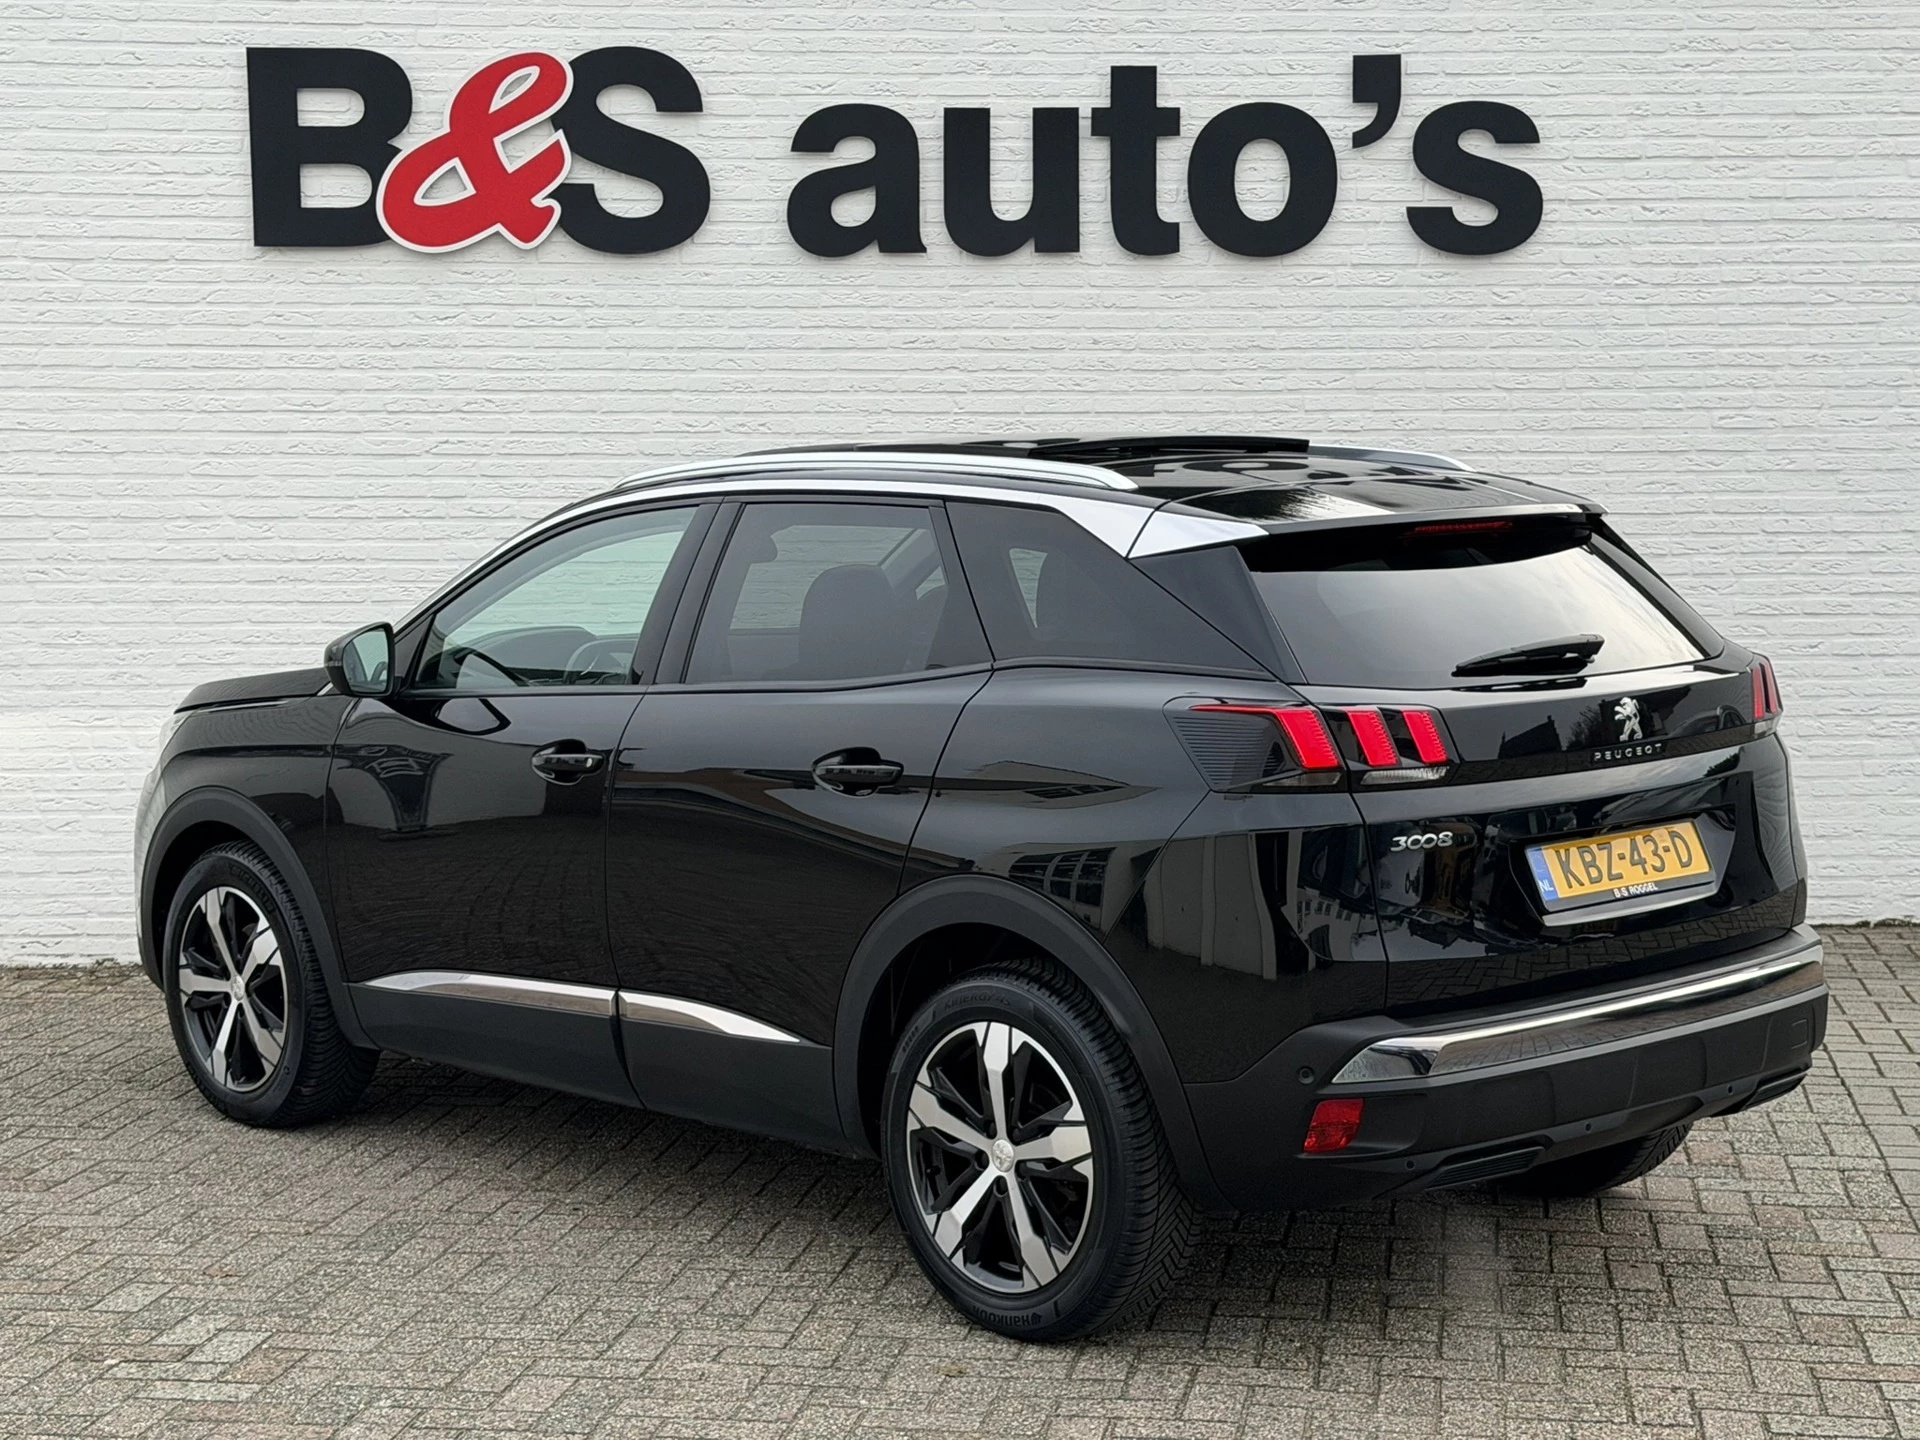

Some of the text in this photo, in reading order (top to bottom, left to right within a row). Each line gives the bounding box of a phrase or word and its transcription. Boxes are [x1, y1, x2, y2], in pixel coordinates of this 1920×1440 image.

[246, 45, 1543, 258] B&S auto's
[1593, 743, 1662, 762] PEUGEOT
[1390, 831, 1453, 852] 3008
[1554, 830, 1693, 889] KBZ-43-D
[1538, 879, 1554, 893] NL
[1628, 882, 1659, 896] ROGGEL
